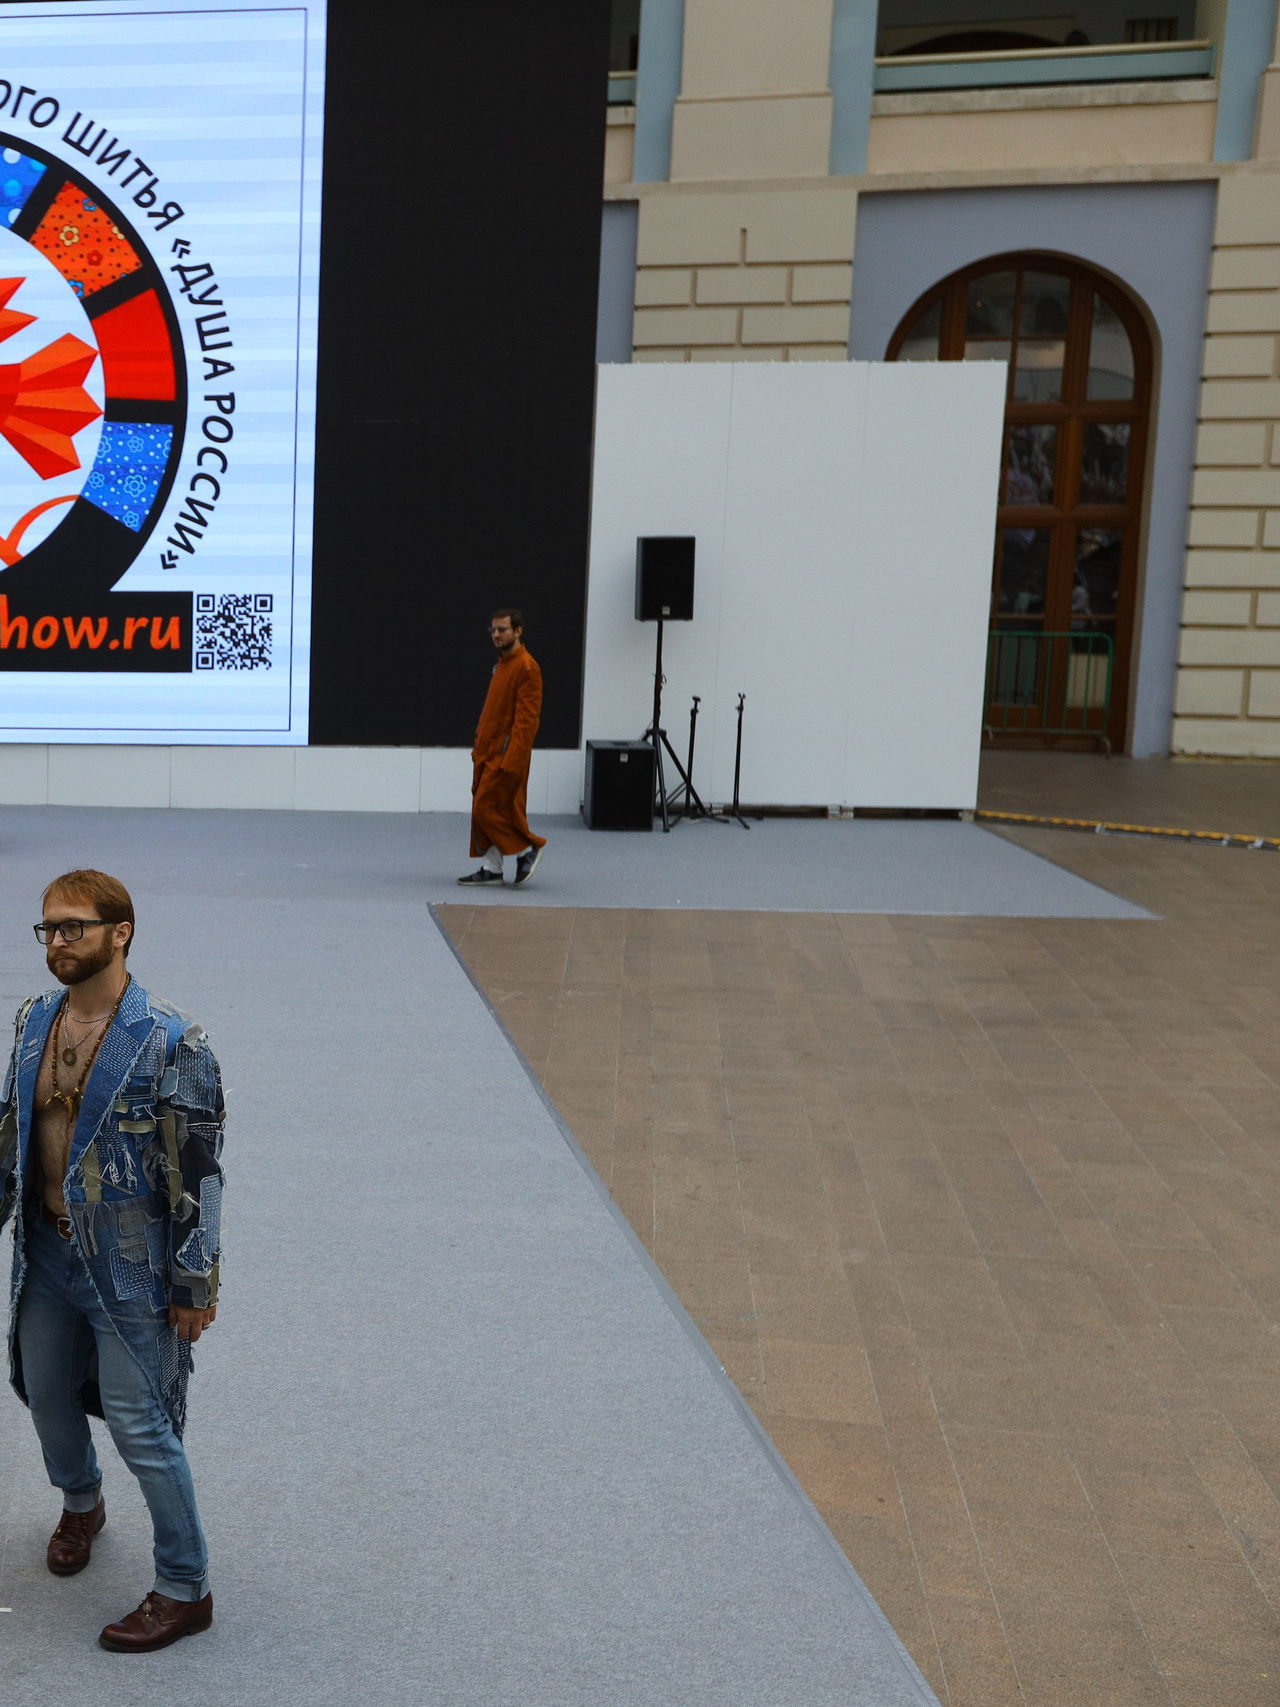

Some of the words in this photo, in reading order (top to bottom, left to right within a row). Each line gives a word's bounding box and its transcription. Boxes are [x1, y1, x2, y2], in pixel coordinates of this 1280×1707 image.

[62, 112, 184, 232] ШИТЬЯ
[171, 238, 235, 381] «ДУША
[160, 393, 236, 571] РОССИИ»
